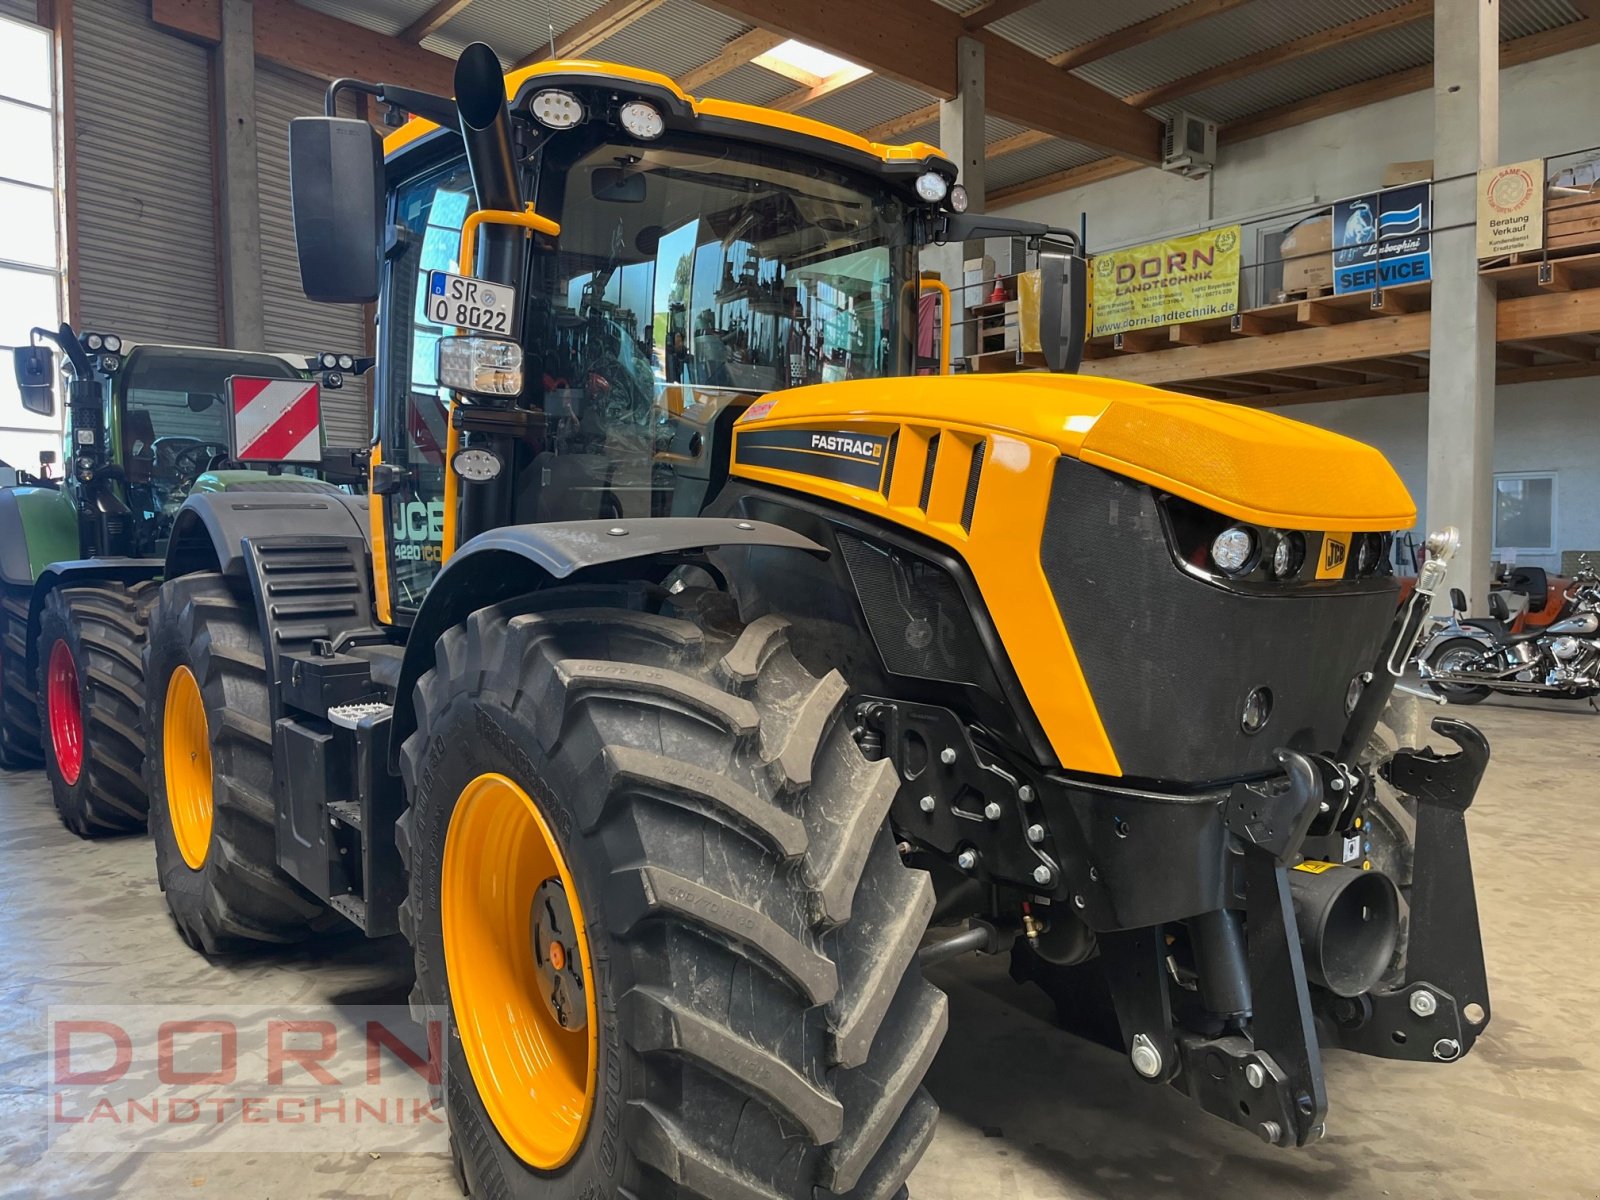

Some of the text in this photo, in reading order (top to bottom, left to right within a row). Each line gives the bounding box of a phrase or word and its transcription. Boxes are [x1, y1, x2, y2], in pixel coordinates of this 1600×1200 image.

[1499, 168, 1521, 178] SAME
[1489, 215, 1529, 228] Beratung
[1492, 224, 1526, 236] Verkauf
[1363, 237, 1421, 257] Lamborghini
[1489, 235, 1529, 246] Kundendienst
[1115, 246, 1214, 284] DORN
[1340, 260, 1425, 289] SERVICE
[451, 279, 477, 303] SR
[1115, 270, 1212, 296] LANDTECHNIK
[456, 304, 507, 332] 8022
[1096, 302, 1235, 333] www.dorn-landtechnik.de
[811, 434, 873, 456] FASTRAC
[394, 544, 420, 560] 4220
